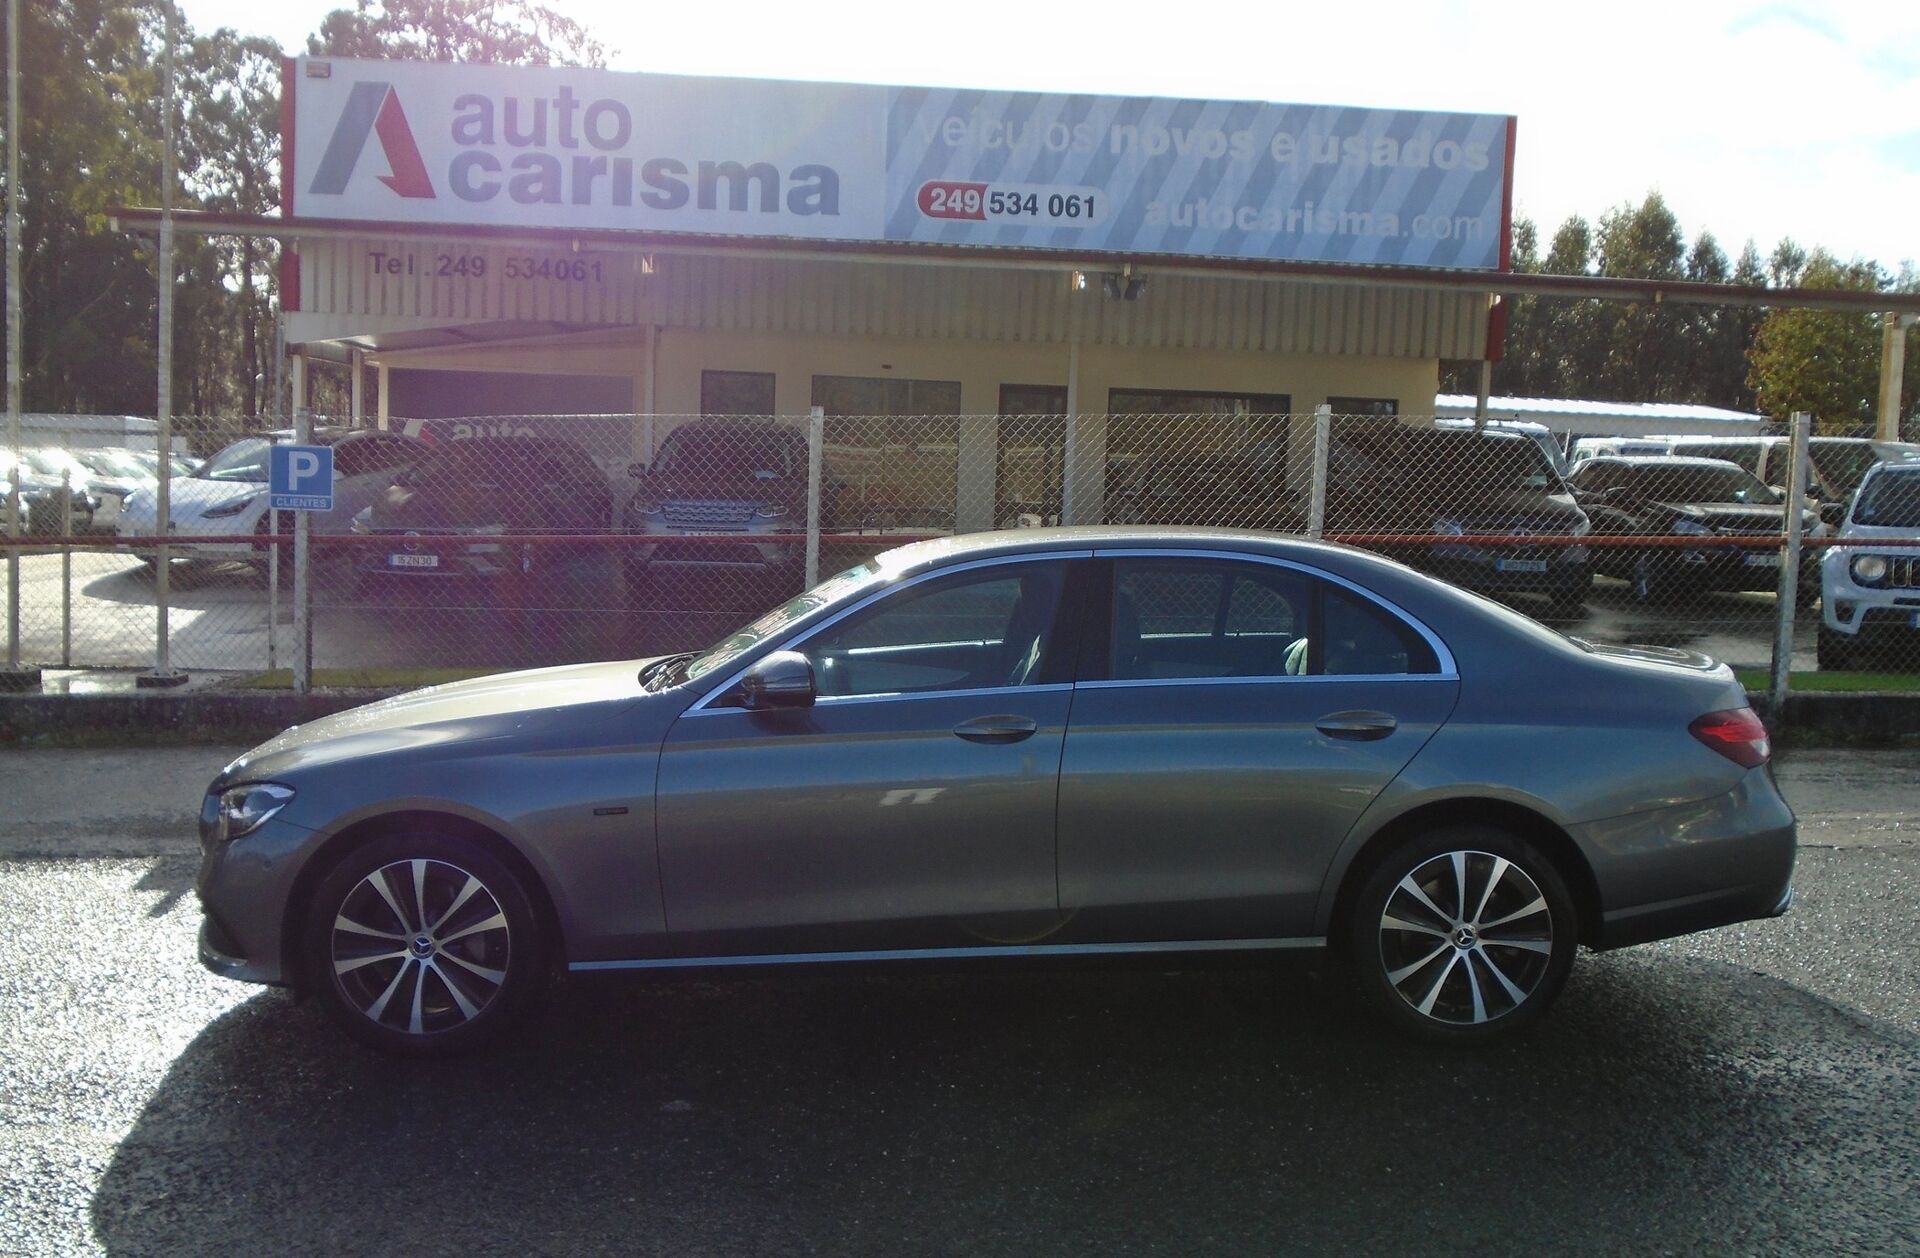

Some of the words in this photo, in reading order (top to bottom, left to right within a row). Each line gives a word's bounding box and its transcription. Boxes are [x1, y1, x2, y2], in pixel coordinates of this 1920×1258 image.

[450, 85, 633, 151] auto
[1110, 122, 1254, 161] novos
[1271, 130, 1296, 163] e
[1311, 125, 1490, 172] usados
[448, 149, 841, 216] carisma
[930, 187, 980, 215] 249
[989, 190, 1039, 216] 534
[1048, 193, 1095, 218] 061
[1144, 195, 1484, 241] autocarisma.com
[437, 254, 486, 278] 249
[505, 257, 602, 282] 534061
[288, 450, 320, 491] P
[276, 497, 327, 508] CLIENTES
